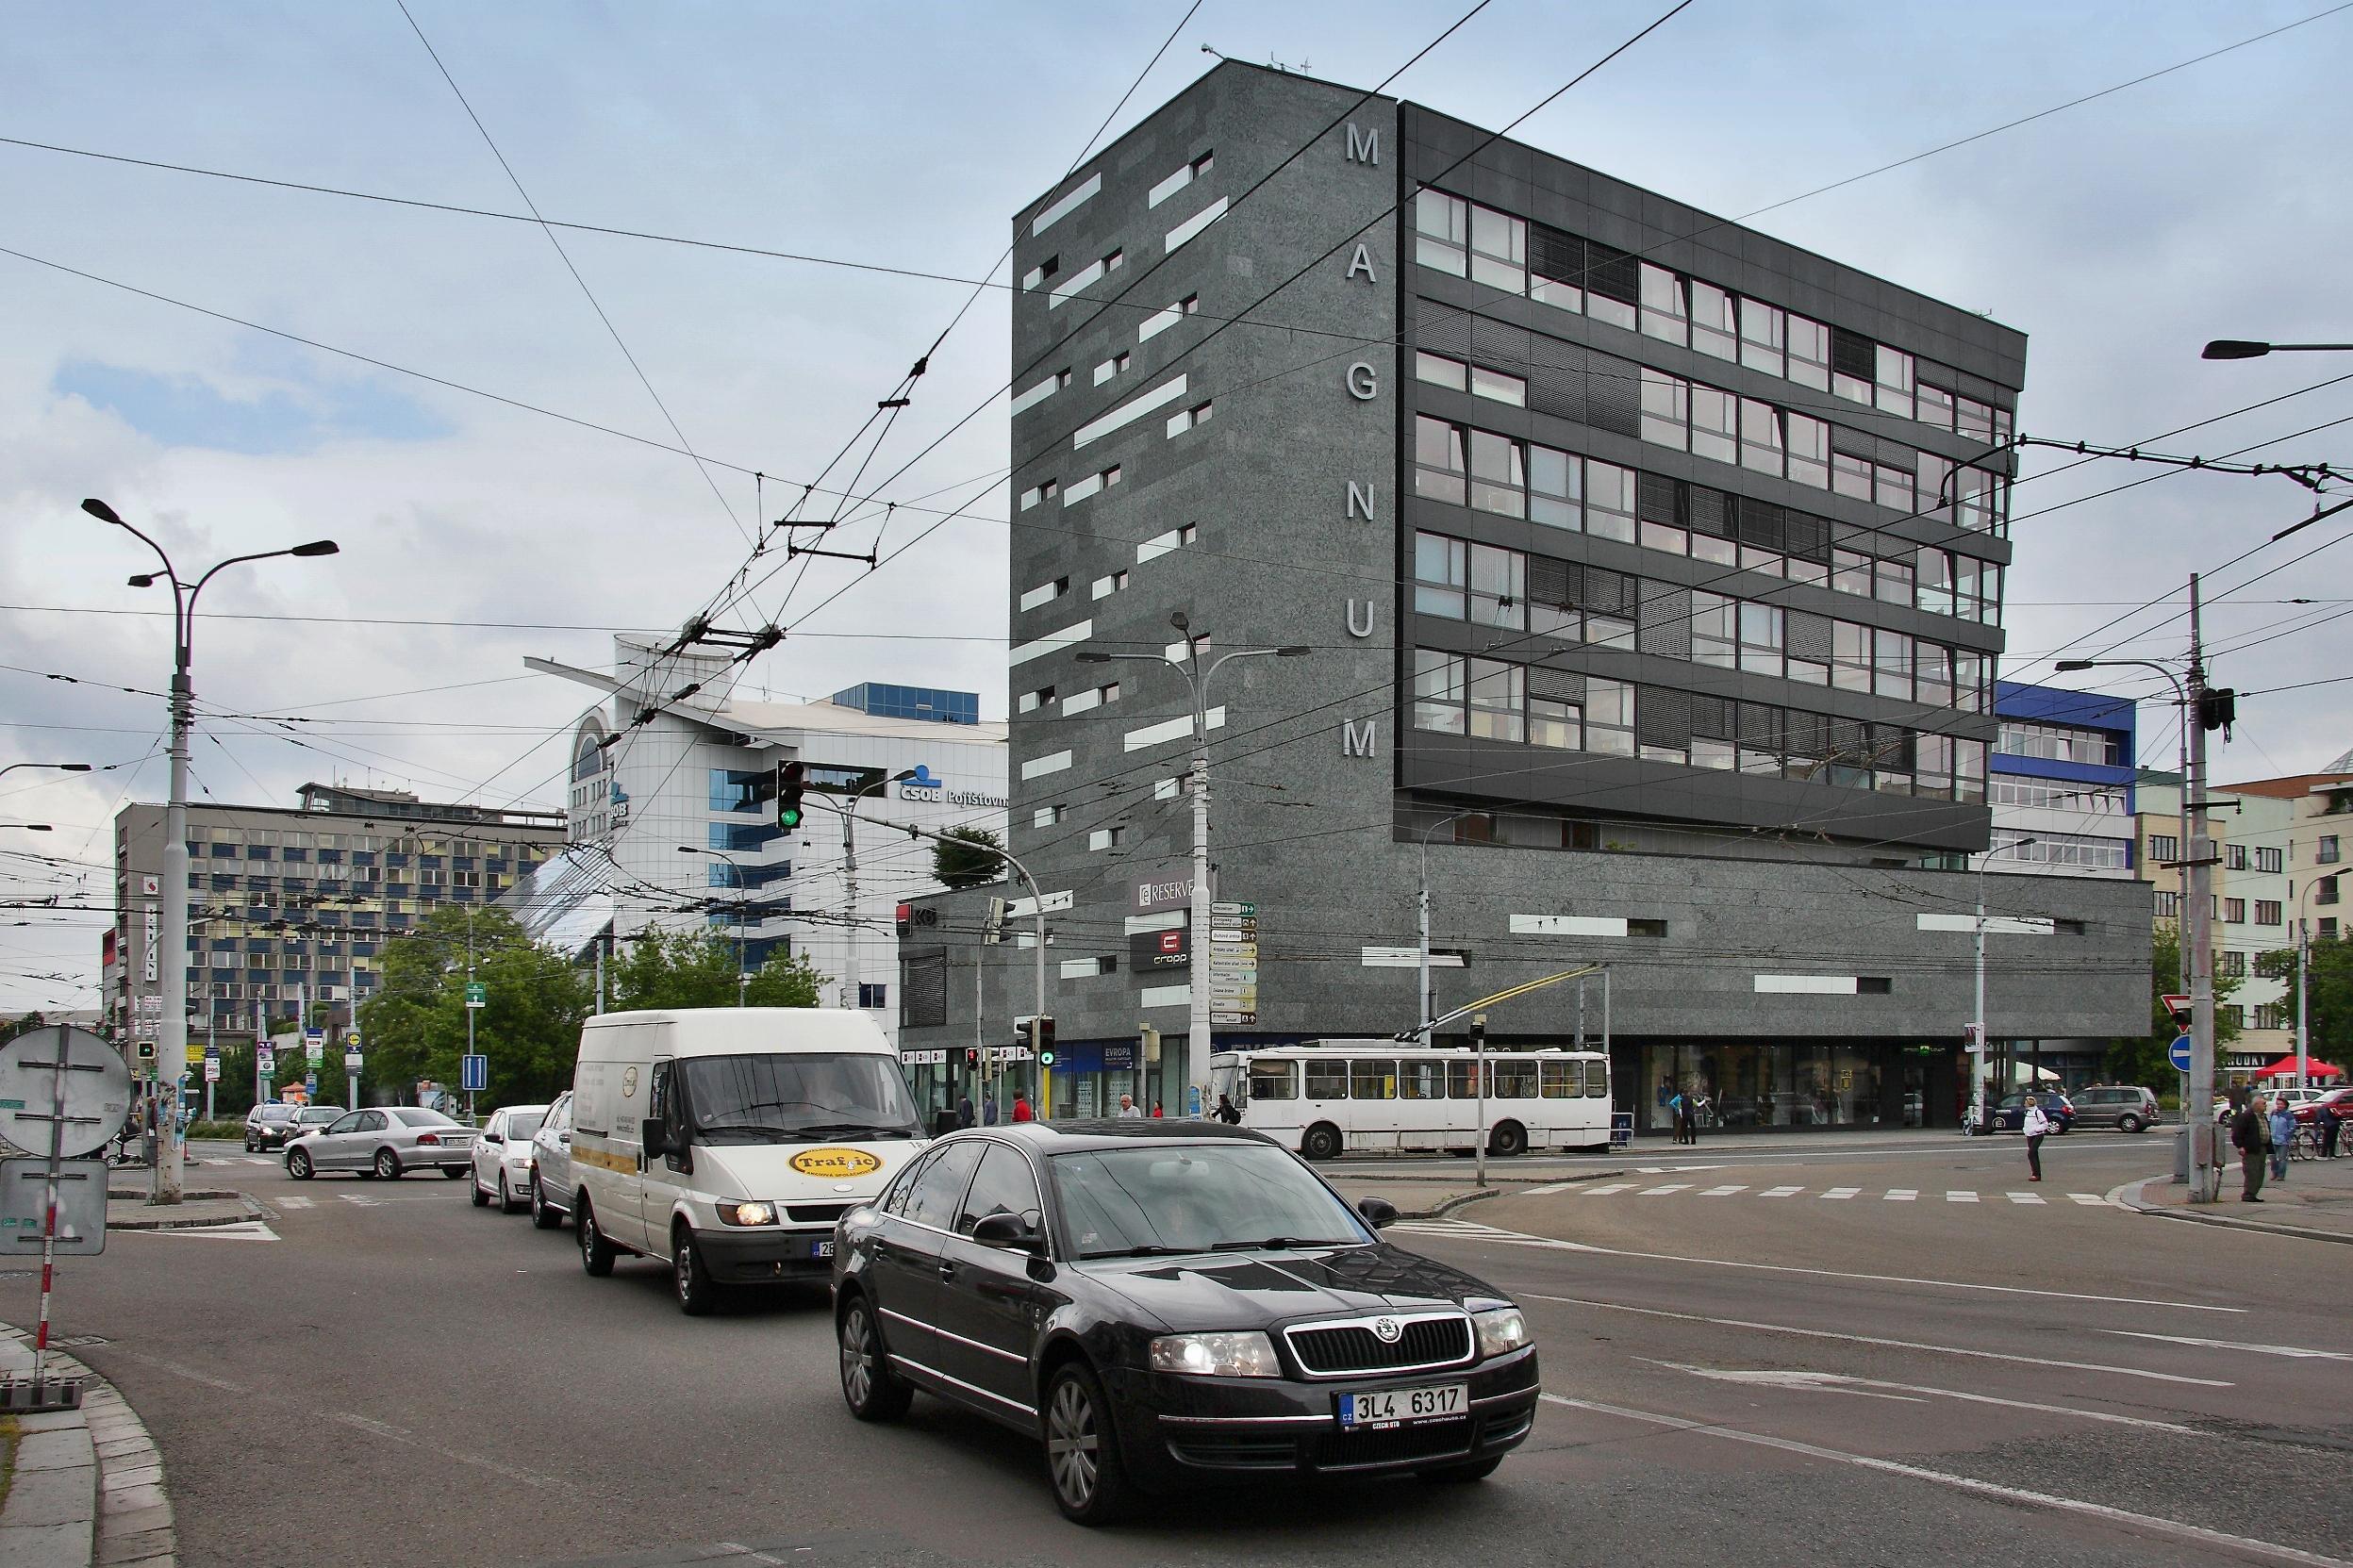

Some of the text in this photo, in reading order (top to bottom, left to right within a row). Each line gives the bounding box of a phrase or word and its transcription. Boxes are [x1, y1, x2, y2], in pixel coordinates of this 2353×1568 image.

[1345, 122, 1379, 757] MAGNUM
[901, 784, 942, 801] ČSOB
[1152, 879, 1195, 902] RESERVE
[1154, 953, 1187, 965] cropp
[1105, 1047, 1131, 1057] EVROPA
[1358, 1395, 1395, 1419] 3L4
[1411, 1388, 1459, 1414] 6317
